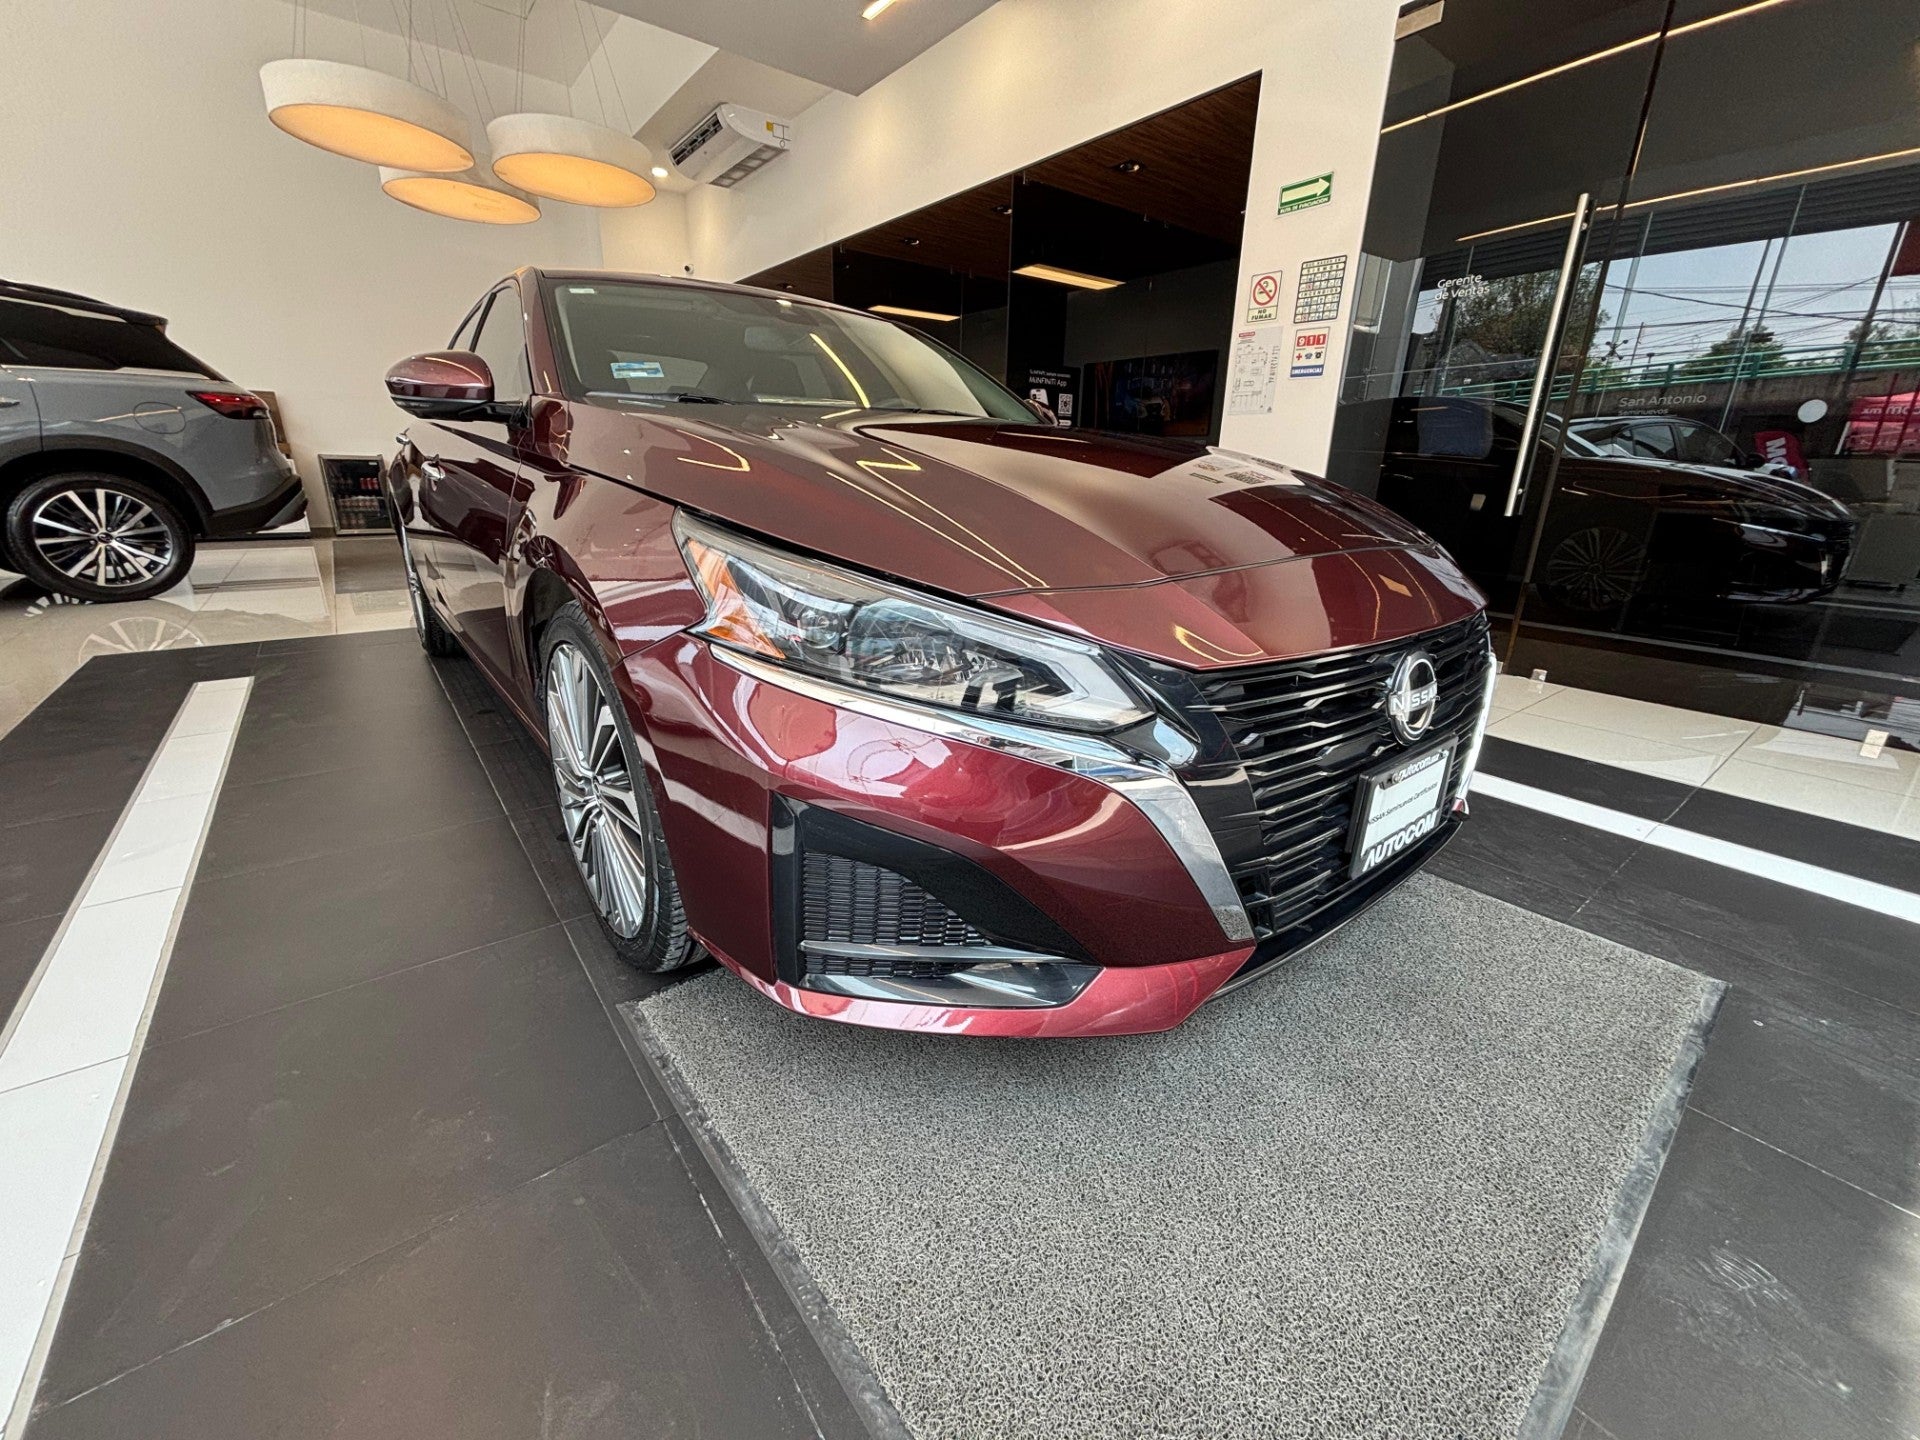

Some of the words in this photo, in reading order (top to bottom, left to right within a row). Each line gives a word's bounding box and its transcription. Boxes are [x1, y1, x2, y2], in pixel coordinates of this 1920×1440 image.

[1437, 275, 1482, 288] Gerente
[1434, 291, 1449, 300] de
[1451, 285, 1490, 298] Ventas
[1299, 335, 1323, 346] 911
[1620, 397, 1645, 407] San
[1648, 394, 1707, 405] Antonio
[1363, 809, 1440, 872] AUTOCOM
